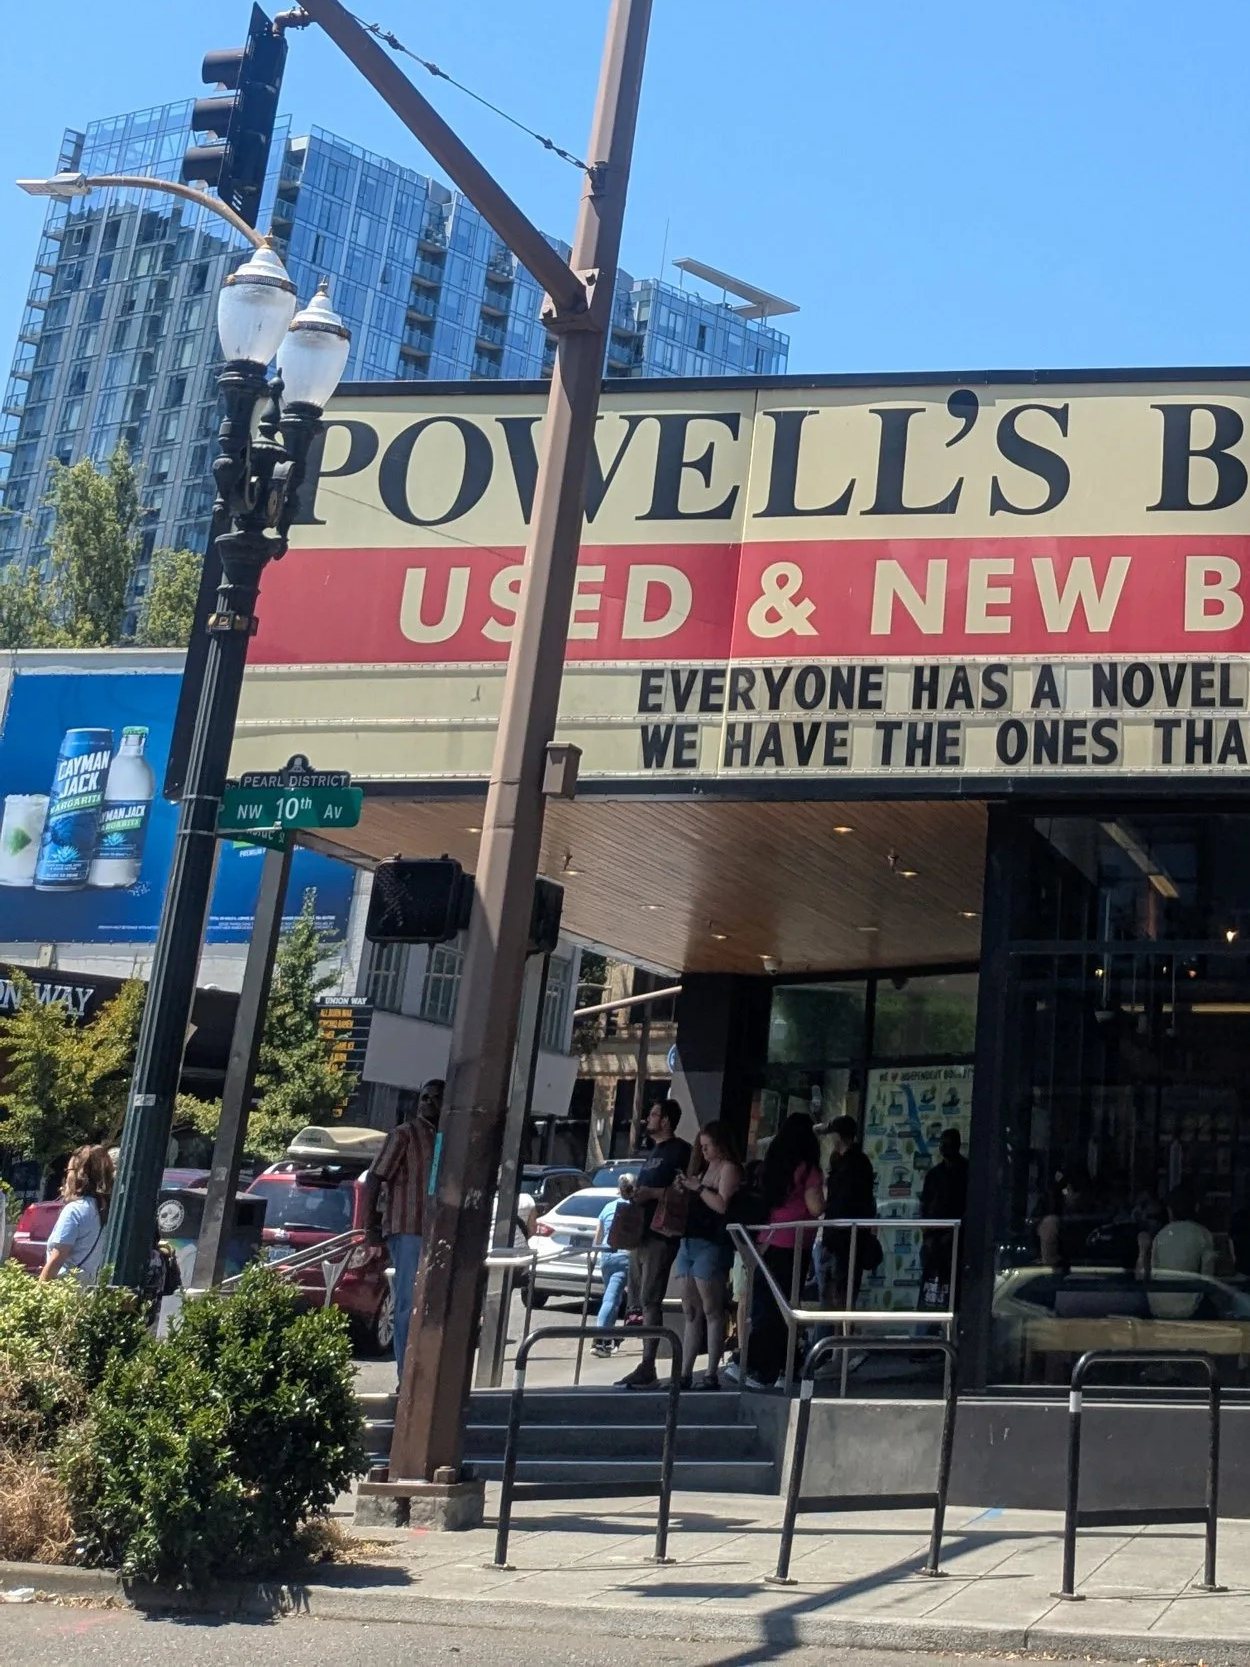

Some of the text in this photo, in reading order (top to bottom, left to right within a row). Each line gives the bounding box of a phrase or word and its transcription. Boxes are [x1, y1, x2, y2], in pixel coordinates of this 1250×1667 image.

[291, 388, 1071, 526] POWELL'S
[399, 563, 693, 644] USED
[746, 561, 819, 637] &
[869, 556, 1132, 635] NEW
[638, 665, 884, 713] EVERYONE
[912, 663, 1008, 710] HAS
[1031, 664, 1060, 708] A
[1092, 662, 1244, 708] NOVEL
[640, 723, 698, 769] WE
[724, 721, 850, 768] HAVE
[875, 720, 961, 767] THE
[996, 718, 1119, 766] ONES
[57, 750, 112, 782] CAYMAN
[243, 776, 284, 788] PEARL
[288, 774, 348, 787] DISTRICT
[58, 771, 100, 799] JACK
[125, 805, 146, 818] JACK
[236, 797, 343, 820] NW 10th Av
[324, 997, 367, 1005] UNION WAY
